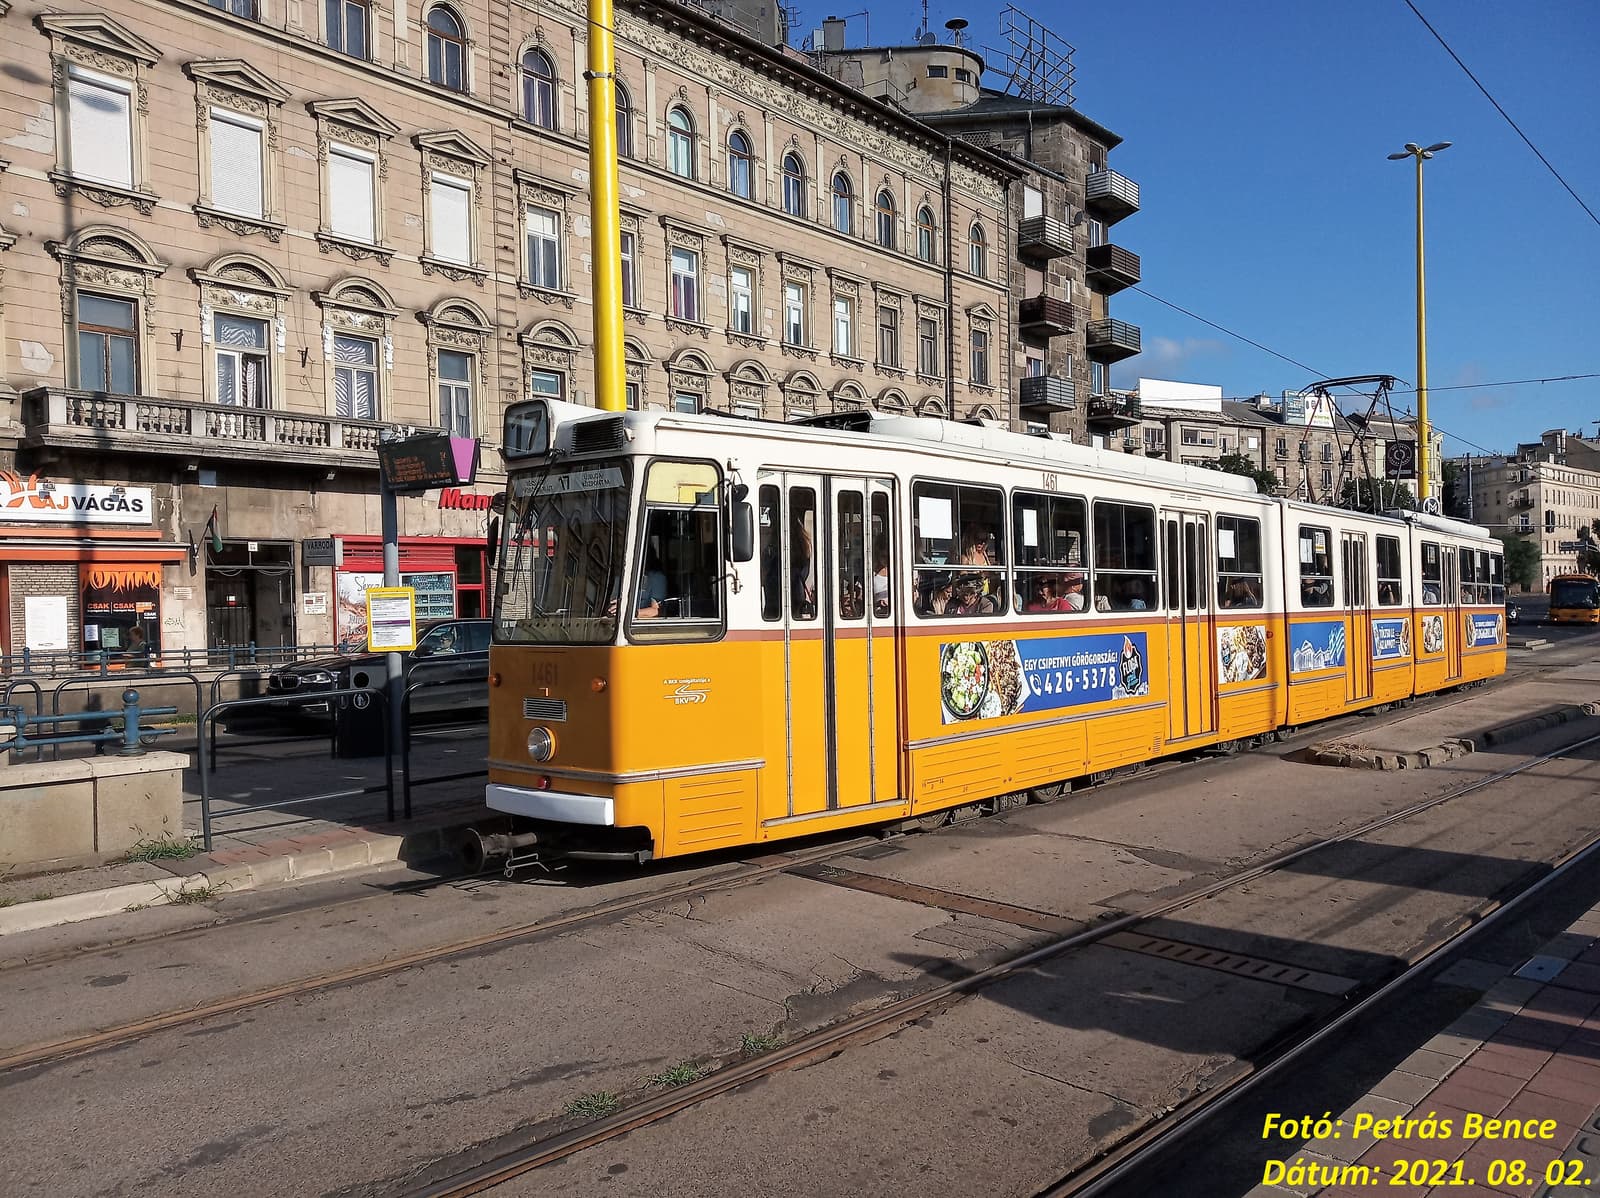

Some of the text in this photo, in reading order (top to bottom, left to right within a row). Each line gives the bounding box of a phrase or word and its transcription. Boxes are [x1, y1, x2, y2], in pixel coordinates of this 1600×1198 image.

[511, 409, 543, 452] 17
[558, 475, 570, 491] 17
[1042, 472, 1058, 491] 1461
[440, 487, 492, 509] Man
[87, 602, 110, 610] CSAK
[1024, 650, 1118, 671] EGY CSIPETNYI GÖRÖGORSZÁG!
[532, 663, 558, 687] 1461
